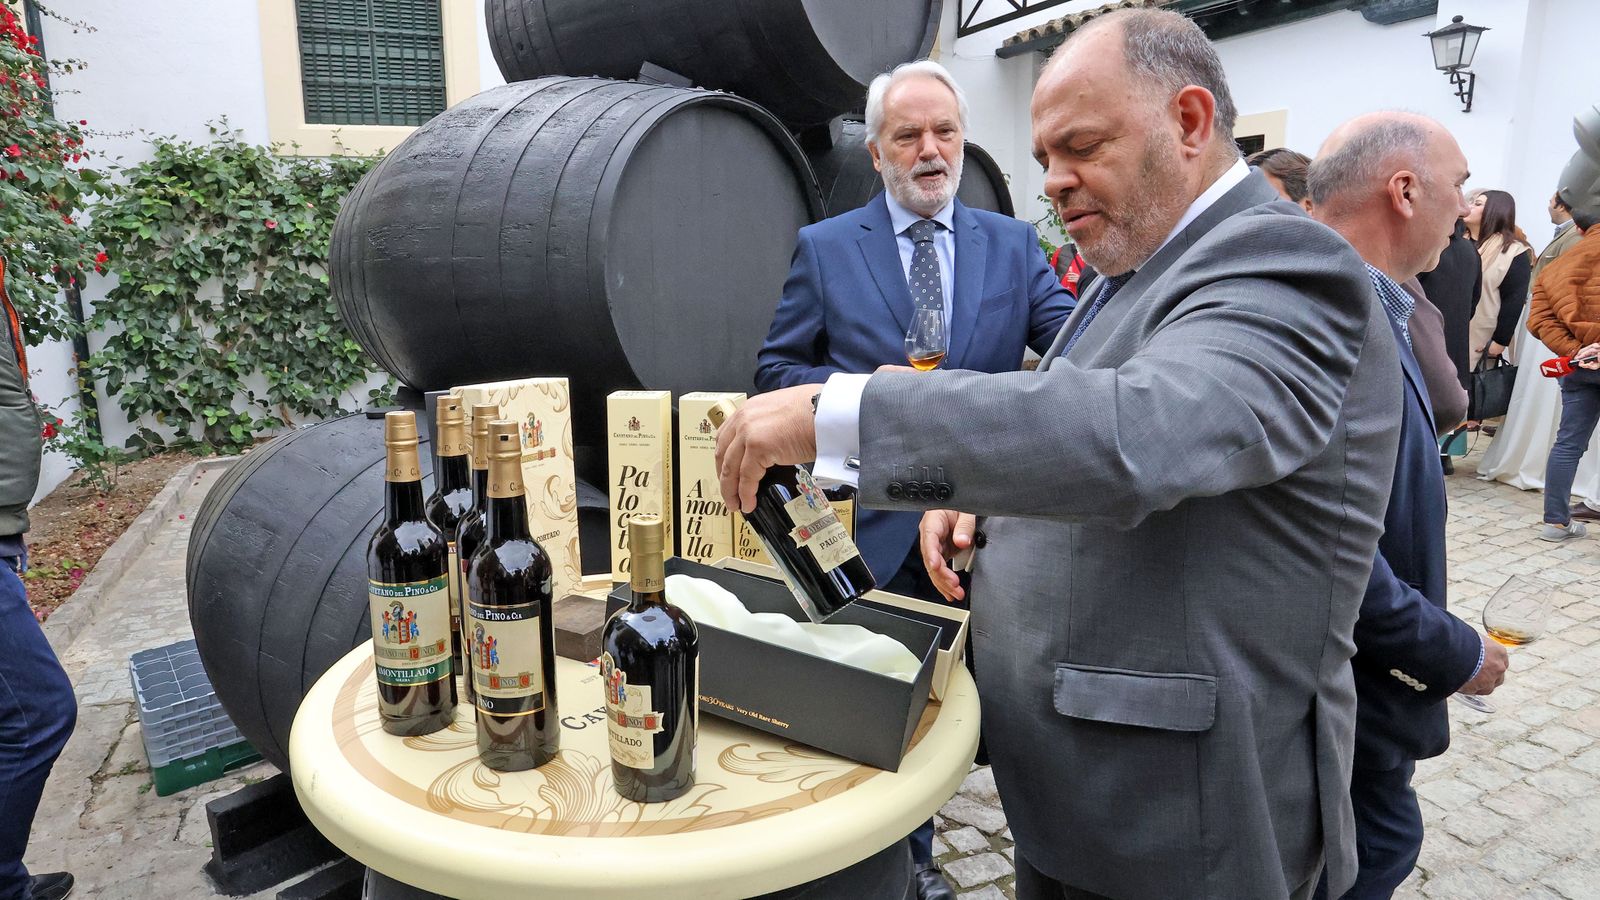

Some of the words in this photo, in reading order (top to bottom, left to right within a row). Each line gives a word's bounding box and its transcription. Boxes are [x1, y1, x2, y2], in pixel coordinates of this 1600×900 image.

[618, 465, 650, 488] Pa
[687, 479, 704, 498] A
[617, 487, 639, 511] lo
[686, 499, 730, 517] mon
[686, 516, 702, 535] ti
[686, 536, 714, 559] lla
[739, 534, 750, 547] lo
[820, 535, 838, 550] PALO
[739, 546, 760, 558] cor
[404, 586, 426, 598] PINO
[485, 609, 506, 621] PINO
[736, 706, 748, 716] Very
[748, 711, 758, 719] Old
[771, 718, 790, 729] Sherry
